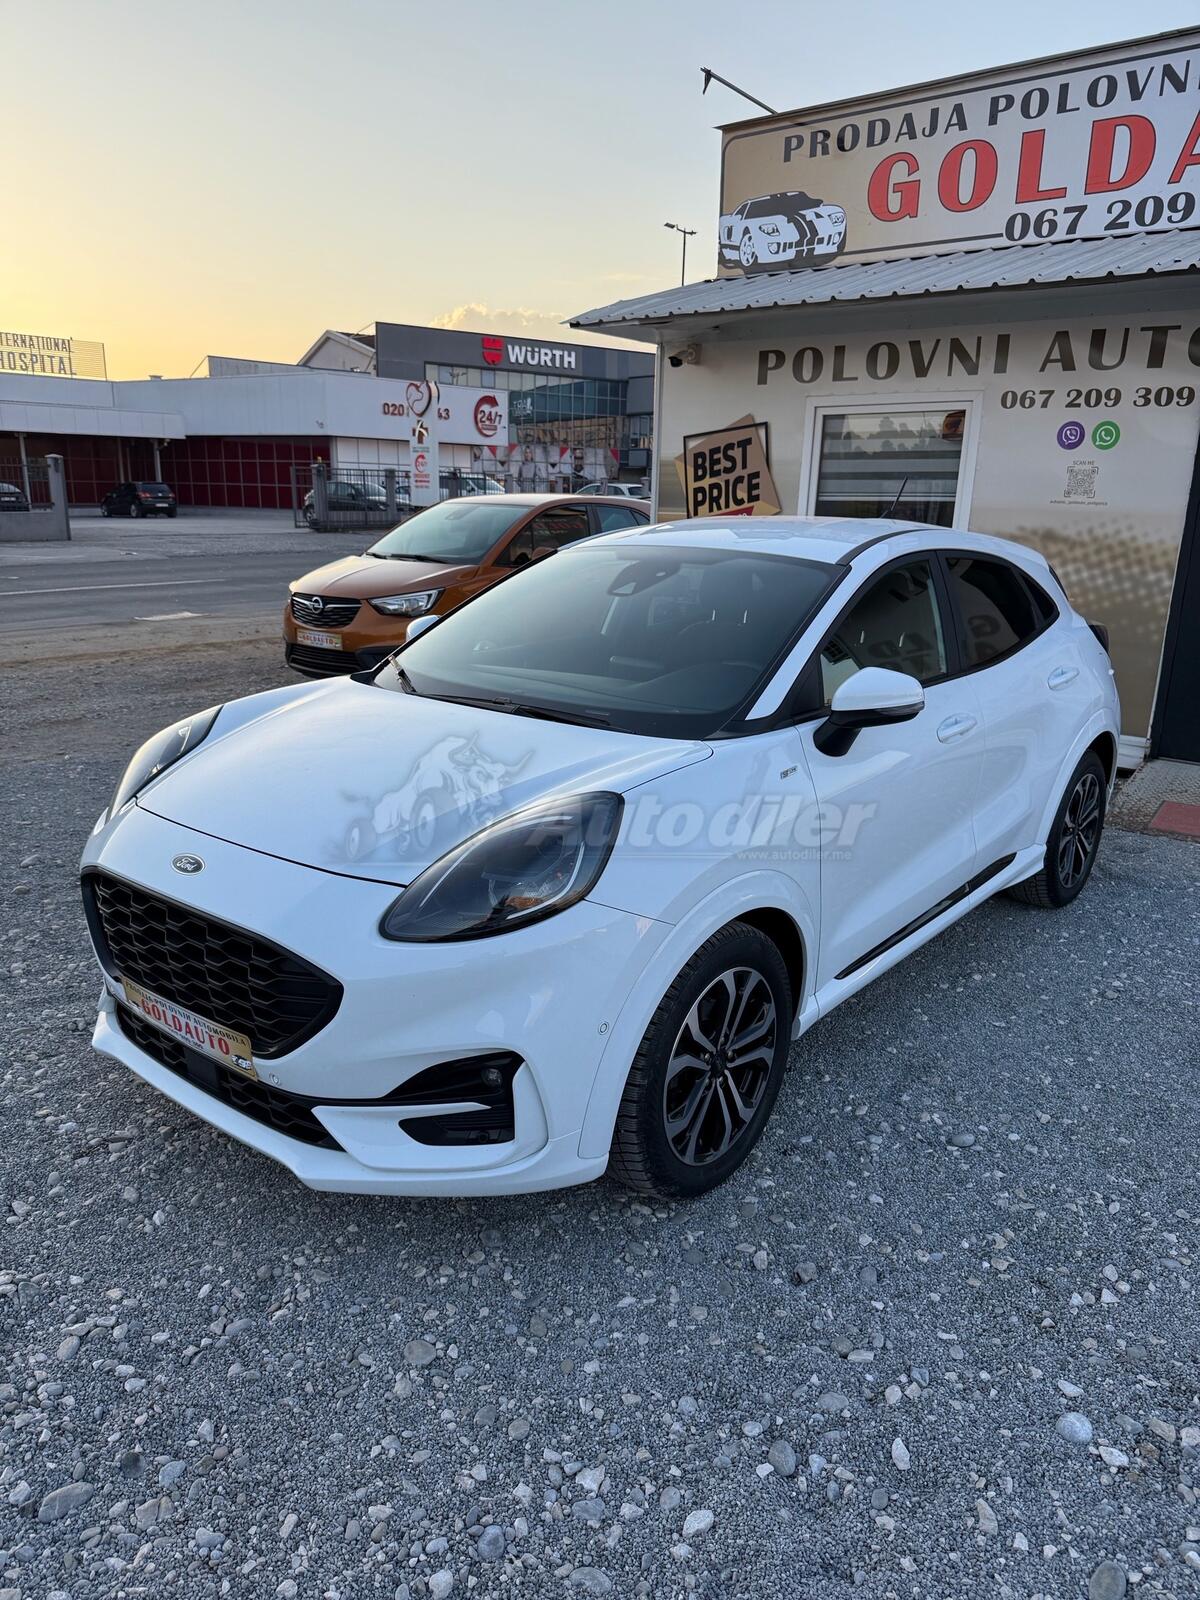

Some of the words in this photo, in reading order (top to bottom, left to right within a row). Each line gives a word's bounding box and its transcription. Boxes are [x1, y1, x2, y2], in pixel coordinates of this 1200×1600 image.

[783, 103, 968, 163] PRODAJA
[988, 59, 1200, 126] POLOVN
[1005, 204, 1088, 242] 067
[1104, 191, 1196, 232] 209
[507, 344, 576, 369] WÜRTH
[757, 334, 1011, 386] POLOVNI
[383, 403, 405, 417] 020
[1000, 389, 1056, 410] 067
[1065, 388, 1122, 409] 209
[1133, 386, 1195, 408] 309
[693, 437, 753, 483] BEST
[692, 470, 761, 517] PRICE
[141, 998, 230, 1055] GOLDAUTO
